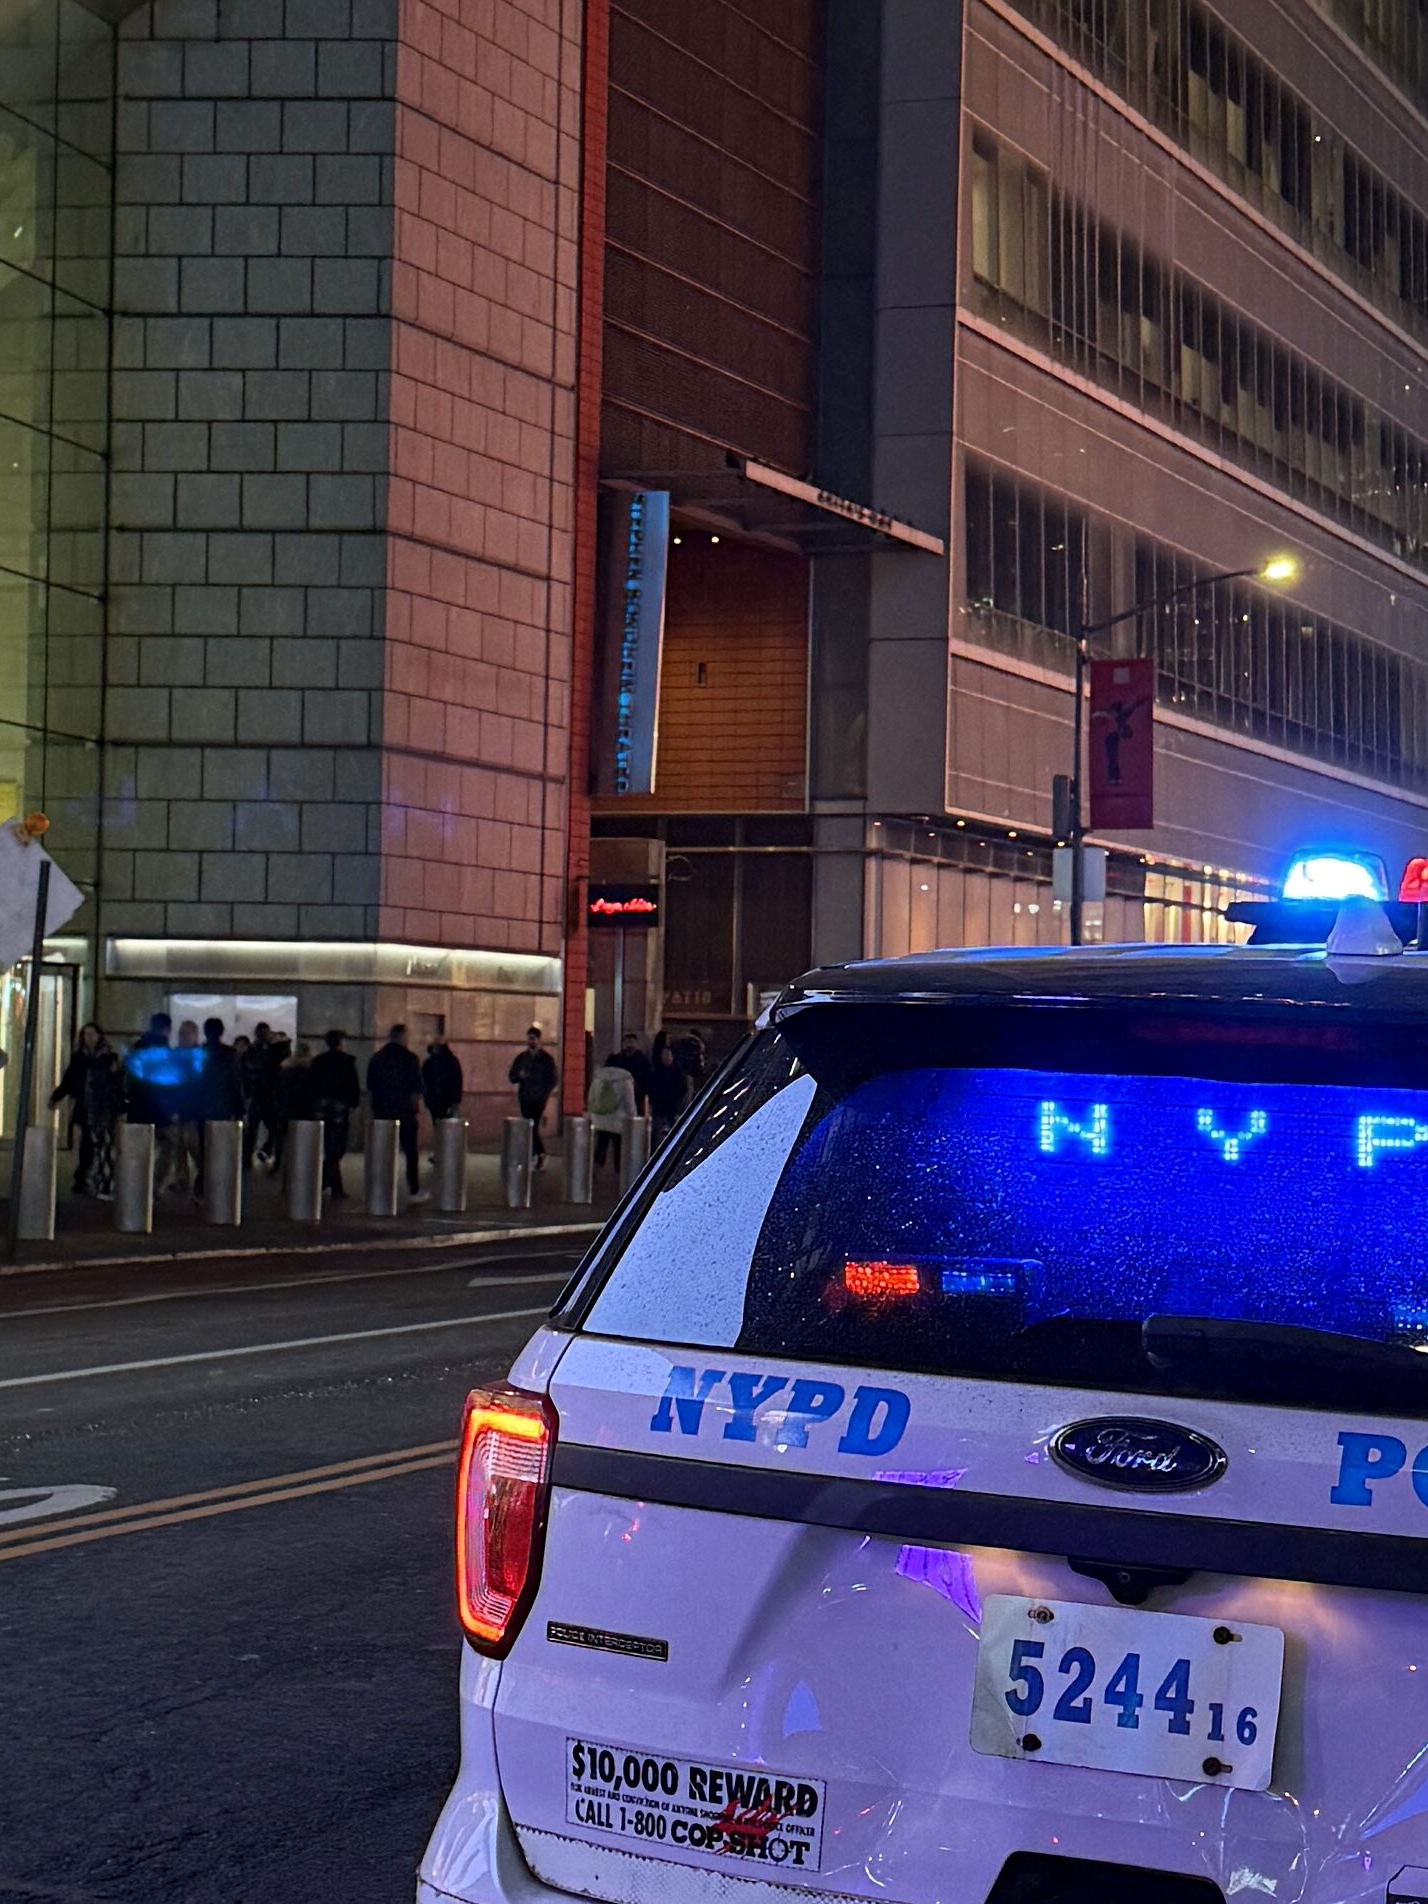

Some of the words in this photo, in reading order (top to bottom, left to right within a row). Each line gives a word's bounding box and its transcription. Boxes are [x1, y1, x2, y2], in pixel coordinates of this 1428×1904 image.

[650, 1365, 912, 1457] NYPD
[1084, 1427, 1180, 1474] Ford
[549, 1626, 586, 1643] POLICE
[1004, 1639, 1195, 1736] 5244
[1206, 1702, 1258, 1747] 16
[571, 1739, 679, 1796] $10,000
[689, 1765, 819, 1818] REWARD
[574, 1798, 614, 1829] CALL
[619, 1806, 667, 1840] 1-800
